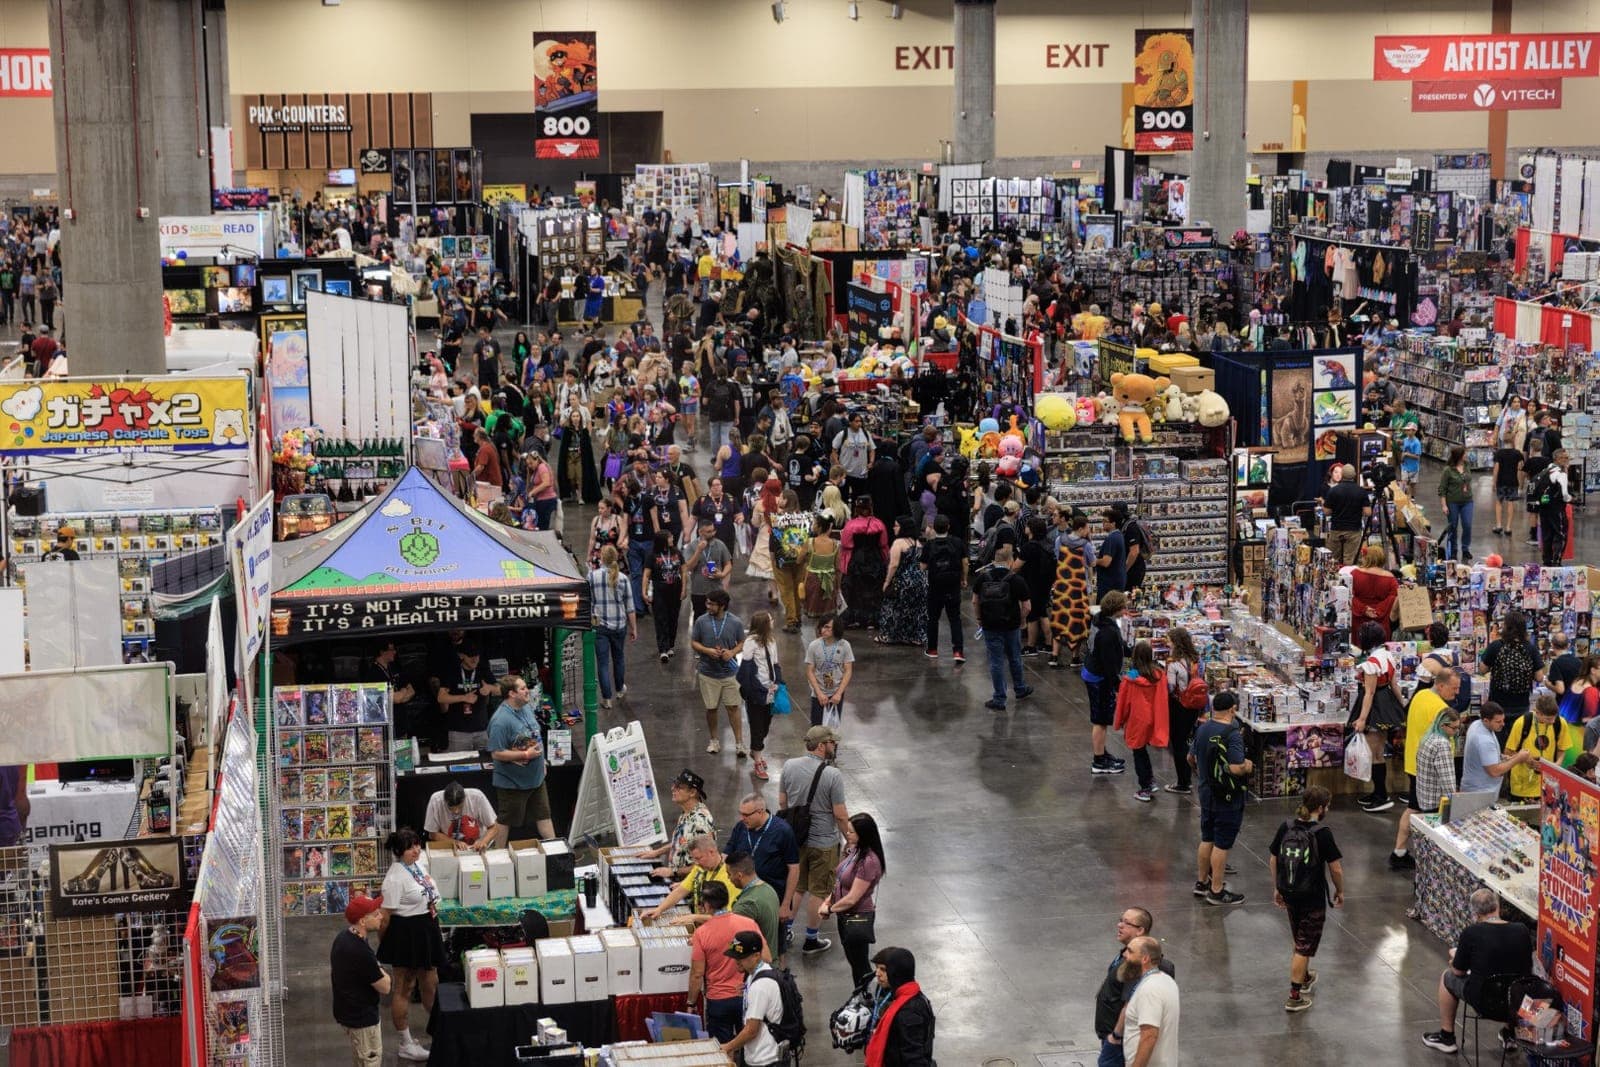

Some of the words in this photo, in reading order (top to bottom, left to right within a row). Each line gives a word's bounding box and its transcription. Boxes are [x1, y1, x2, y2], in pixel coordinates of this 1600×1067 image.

[896, 46, 955, 70] EXIT
[1047, 45, 1109, 68] EXIT
[1443, 42, 1520, 72] ARTIST
[1524, 40, 1592, 70] ALLEY
[1418, 93, 1457, 101] PRESENTED
[249, 106, 274, 124] PHX
[282, 105, 346, 123] COUNTERS
[543, 116, 591, 136] 800
[1142, 110, 1187, 130] 900
[223, 223, 255, 233] READ
[40, 429, 108, 443] Japanese
[113, 427, 170, 441] Capsule
[175, 426, 209, 440] Toys
[306, 603, 355, 618] IT'S
[366, 599, 403, 613] NOT
[415, 596, 462, 610] JUST
[473, 596, 486, 607] A
[498, 593, 546, 606] BEER
[302, 617, 350, 632] IT'S
[362, 615, 375, 628] A
[386, 610, 459, 626] HEALTH
[469, 605, 550, 621] POTION!
[25, 819, 102, 843] gaming
[1550, 857, 1584, 891] ARIZONA
[72, 897, 100, 907] Kate's
[102, 895, 129, 905] Comic
[131, 892, 170, 903] Geekery
[1545, 875, 1589, 915] TOYCON
